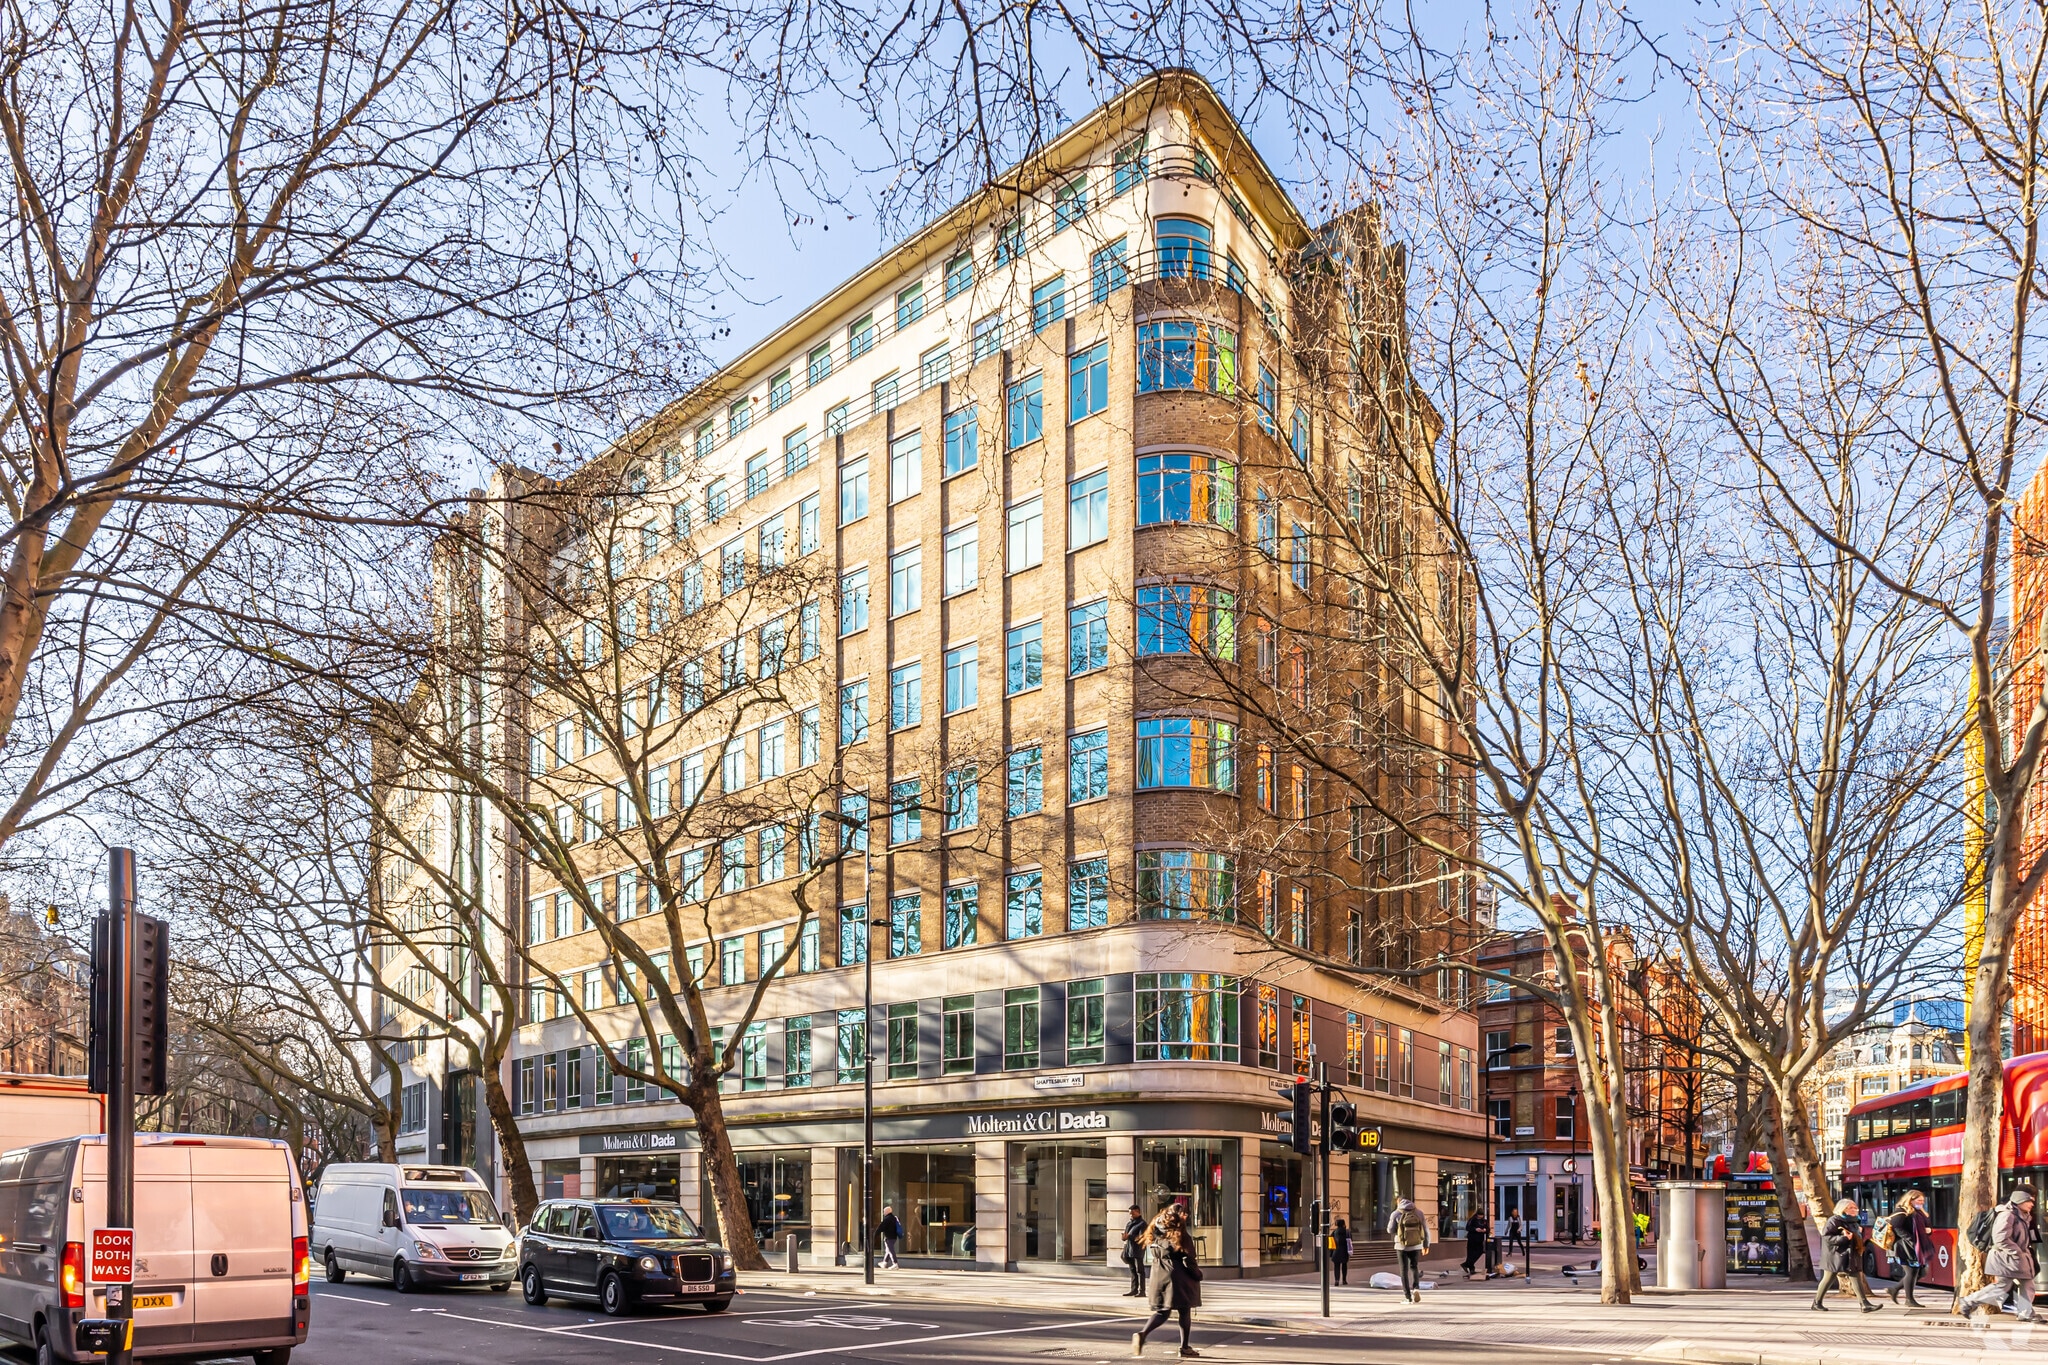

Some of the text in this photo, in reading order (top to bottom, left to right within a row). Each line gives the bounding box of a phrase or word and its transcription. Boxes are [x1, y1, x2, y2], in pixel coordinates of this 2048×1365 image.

[967, 1110, 1106, 1134] Molteni&C Dada
[1312, 1120, 1322, 1136] Da
[602, 1133, 676, 1150] Molteni&C Dada
[1360, 1131, 1378, 1146] 08
[96, 1235, 131, 1246] LOOK
[95, 1250, 130, 1260] BOTH
[93, 1265, 131, 1275] WAYS
[143, 1297, 166, 1307] DXX
